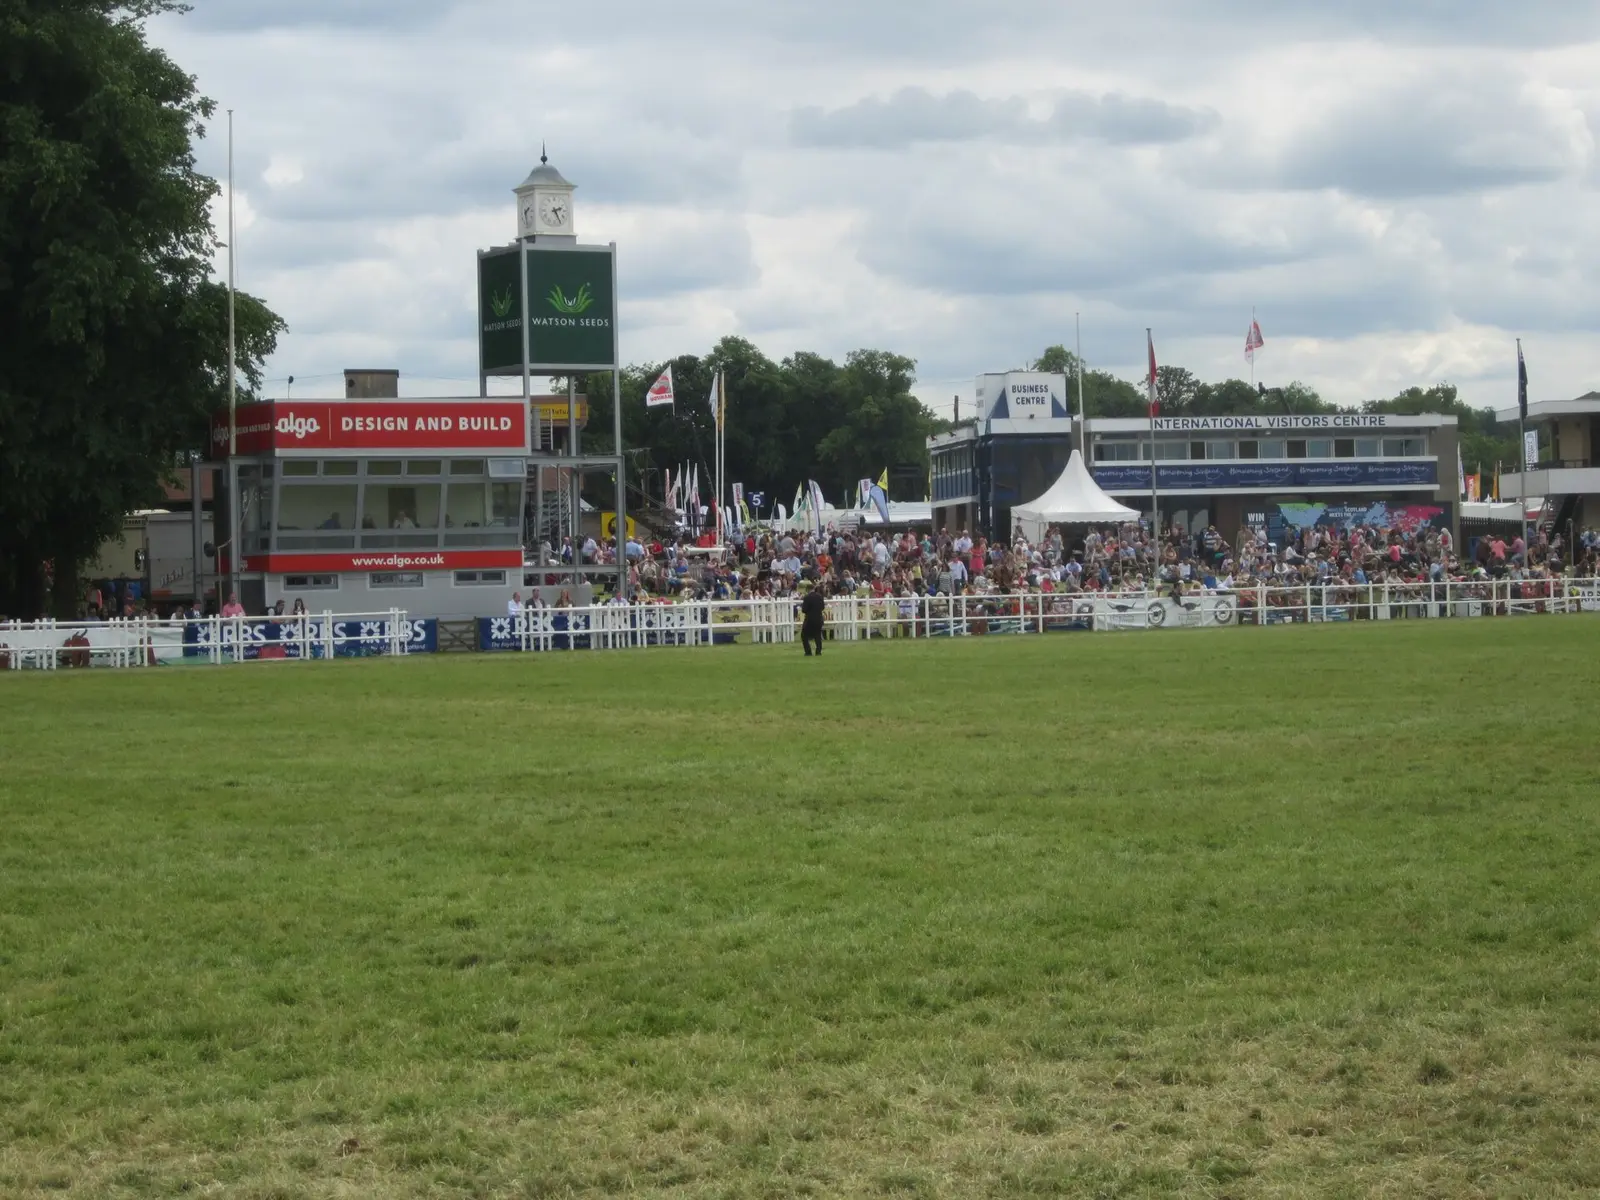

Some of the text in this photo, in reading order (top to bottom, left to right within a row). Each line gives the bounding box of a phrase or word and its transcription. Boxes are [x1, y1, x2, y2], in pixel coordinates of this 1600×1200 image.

[532, 317, 609, 327] WATSON SEEDS
[1011, 384, 1049, 393] BUSINESS
[1015, 396, 1046, 405] CENTRE
[274, 411, 512, 439] algo DESIGN AND BUILD
[1153, 415, 1386, 429] NTERNATIONAL VISITORS CENTRE
[752, 494, 761, 506] 5
[1247, 512, 1265, 522] WIN
[351, 553, 445, 568] www.algo.co.uk
[222, 624, 267, 648] RBS
